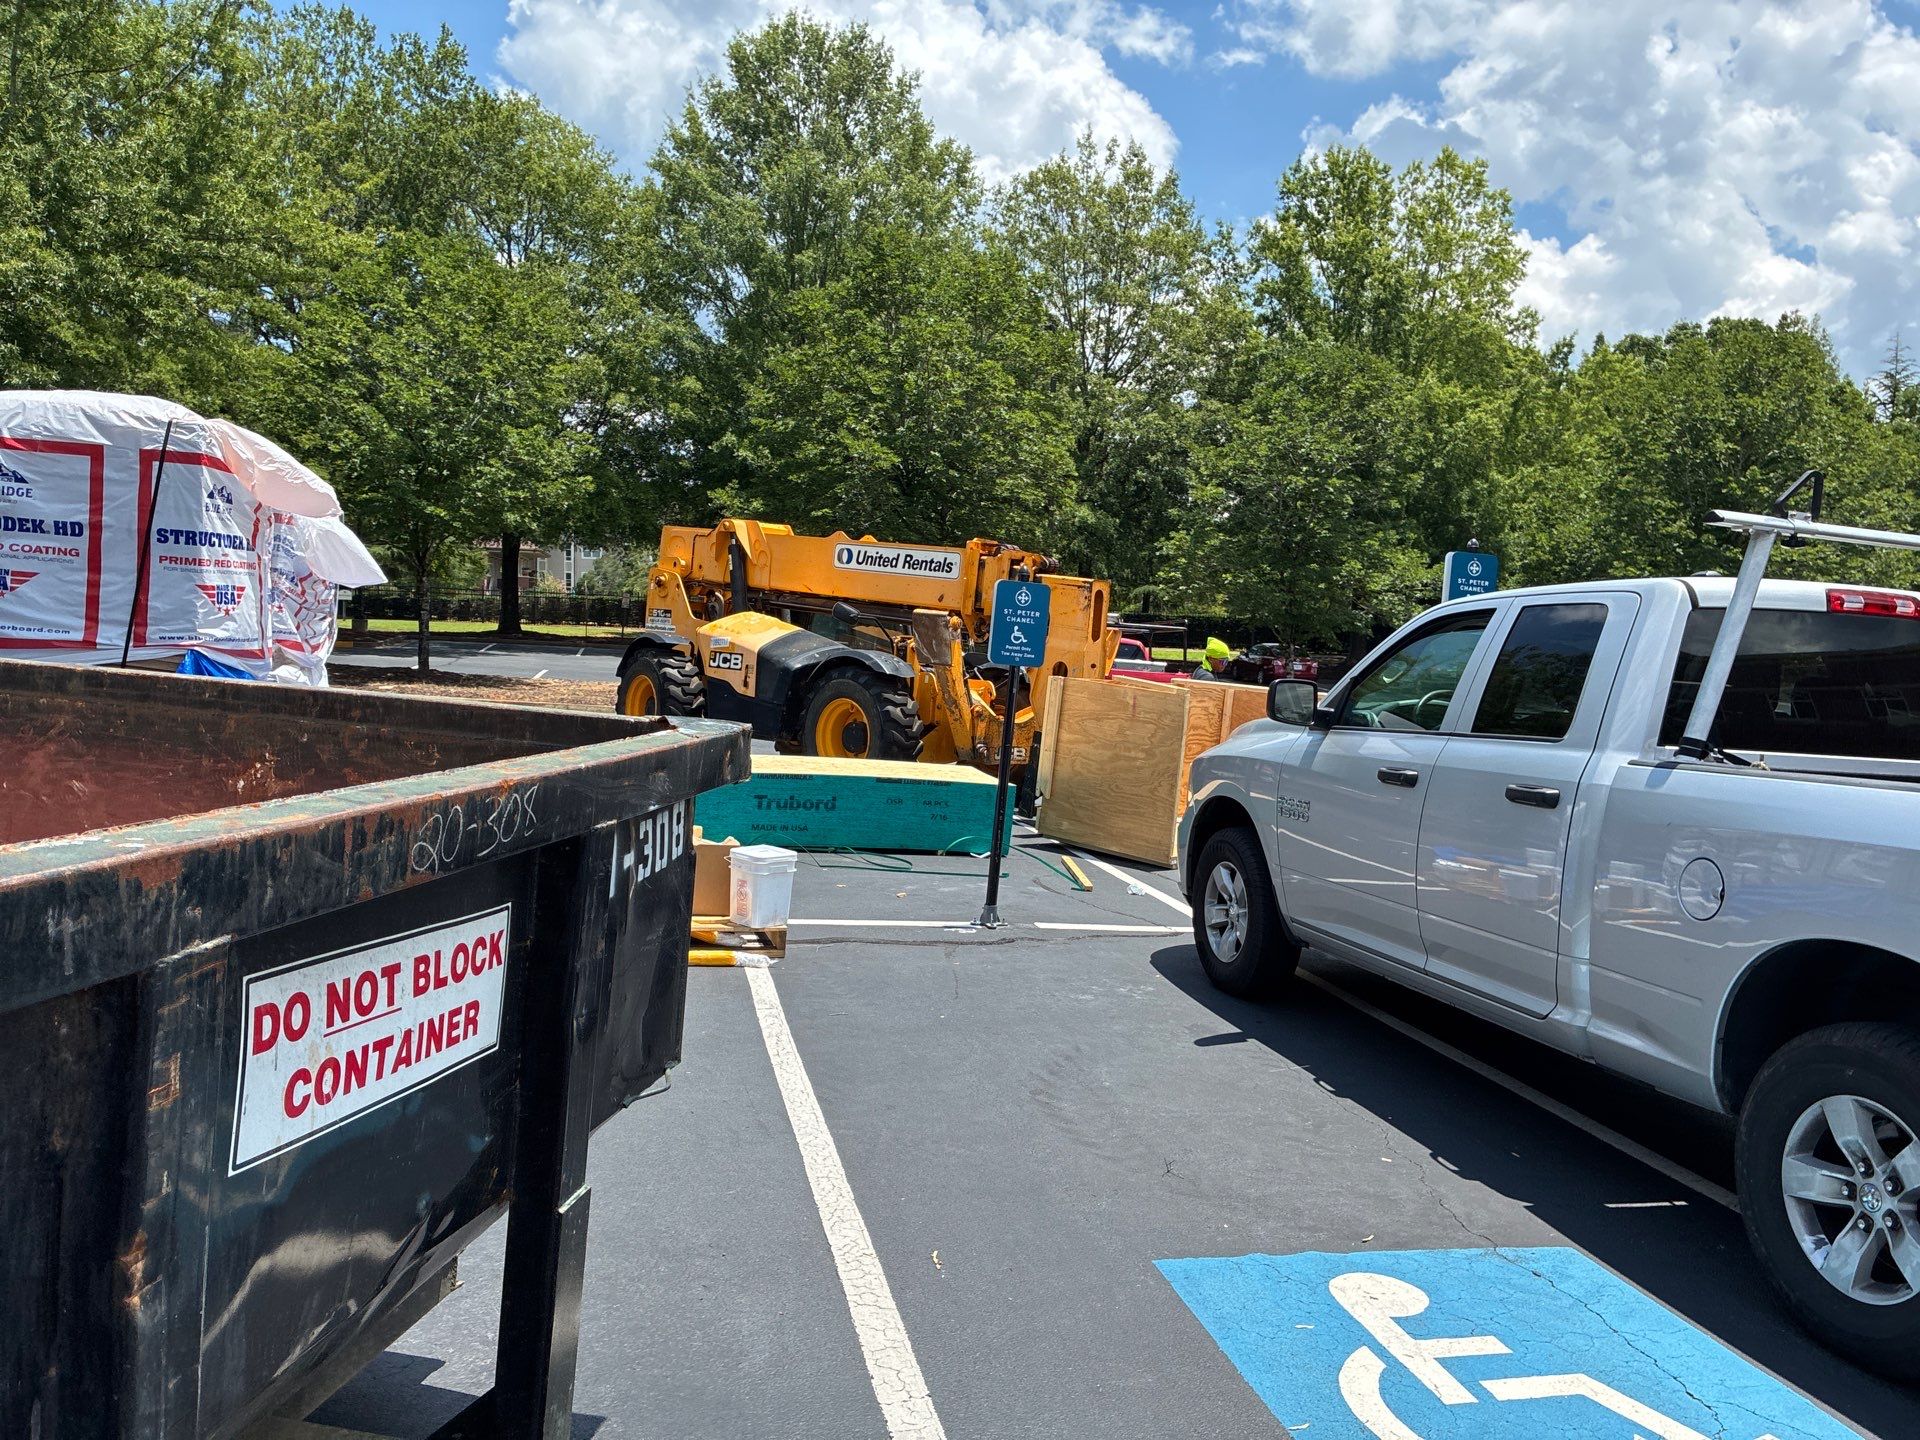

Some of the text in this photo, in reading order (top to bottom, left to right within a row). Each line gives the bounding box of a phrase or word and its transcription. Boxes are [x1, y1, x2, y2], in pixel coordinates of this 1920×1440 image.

[0, 515, 84, 537] DEK HD
[9, 543, 80, 557] COATING
[158, 555, 212, 567] PRIMED
[214, 558, 232, 568] RED
[856, 550, 954, 574] United Rentals
[1460, 585, 1485, 593] CHANEL
[1469, 579, 1489, 587] PETER
[216, 591, 237, 606] USA
[1006, 616, 1035, 625] CHANEL
[1017, 609, 1041, 618] PETER
[710, 652, 742, 670] JCB
[995, 747, 1026, 761] JB
[753, 794, 837, 812] Trubord
[411, 783, 540, 875] 20-308
[751, 823, 809, 832] MADE IN USA
[251, 929, 505, 1057] DO NOT BLOCK
[282, 999, 481, 1119] CONTAINER
